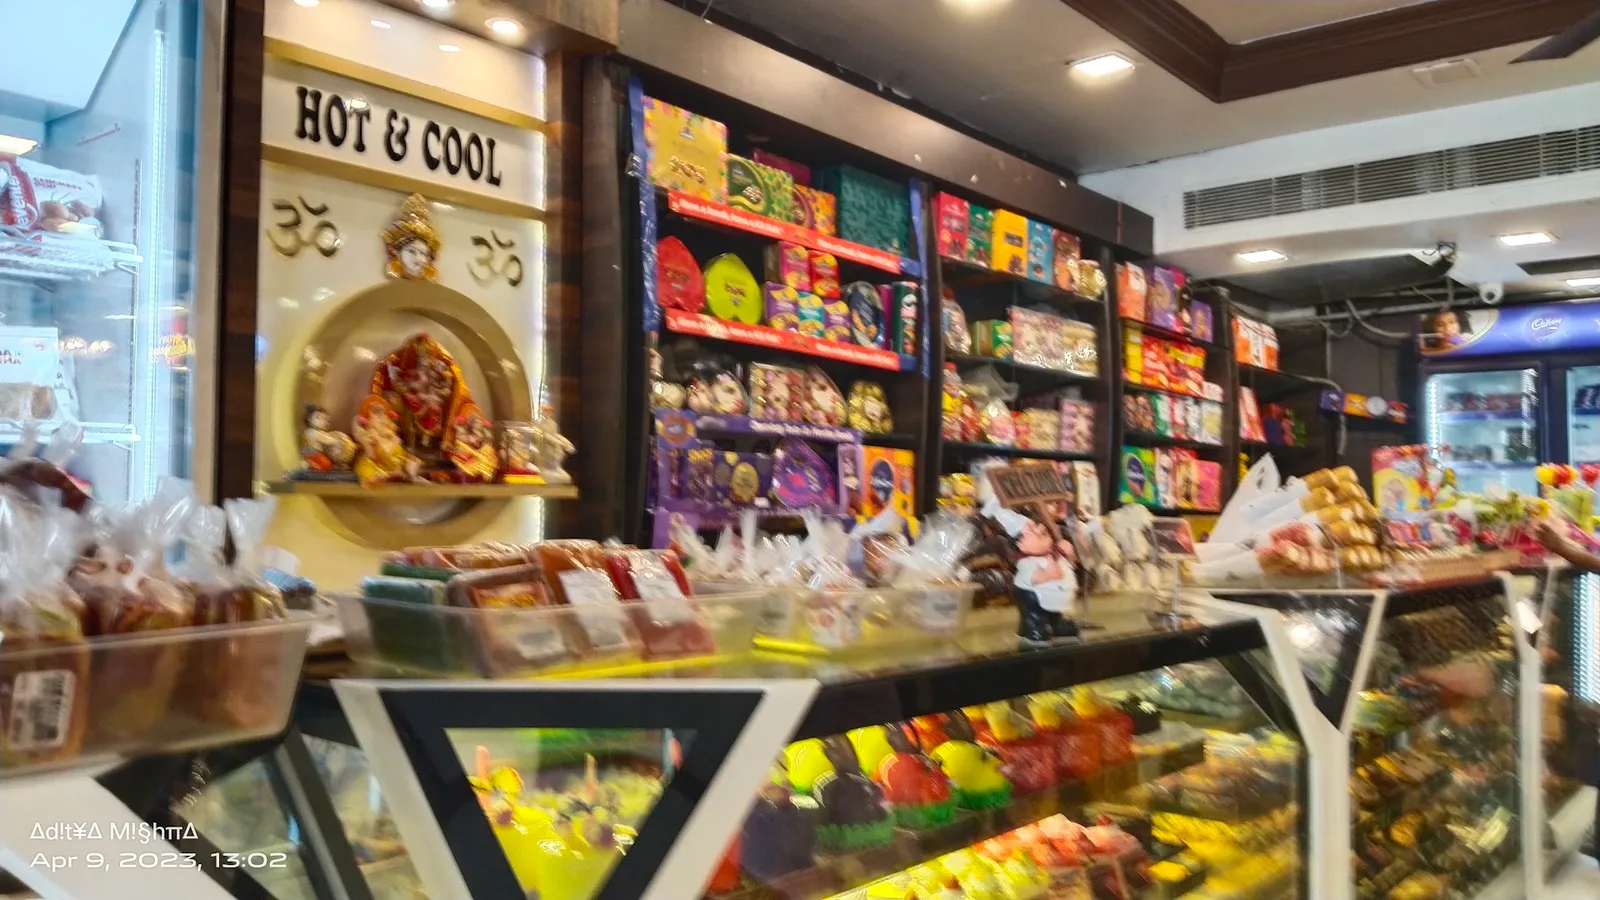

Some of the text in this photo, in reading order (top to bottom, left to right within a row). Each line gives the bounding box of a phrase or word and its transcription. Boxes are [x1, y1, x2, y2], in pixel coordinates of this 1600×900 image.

[296, 86, 502, 187] HOT & COOL
